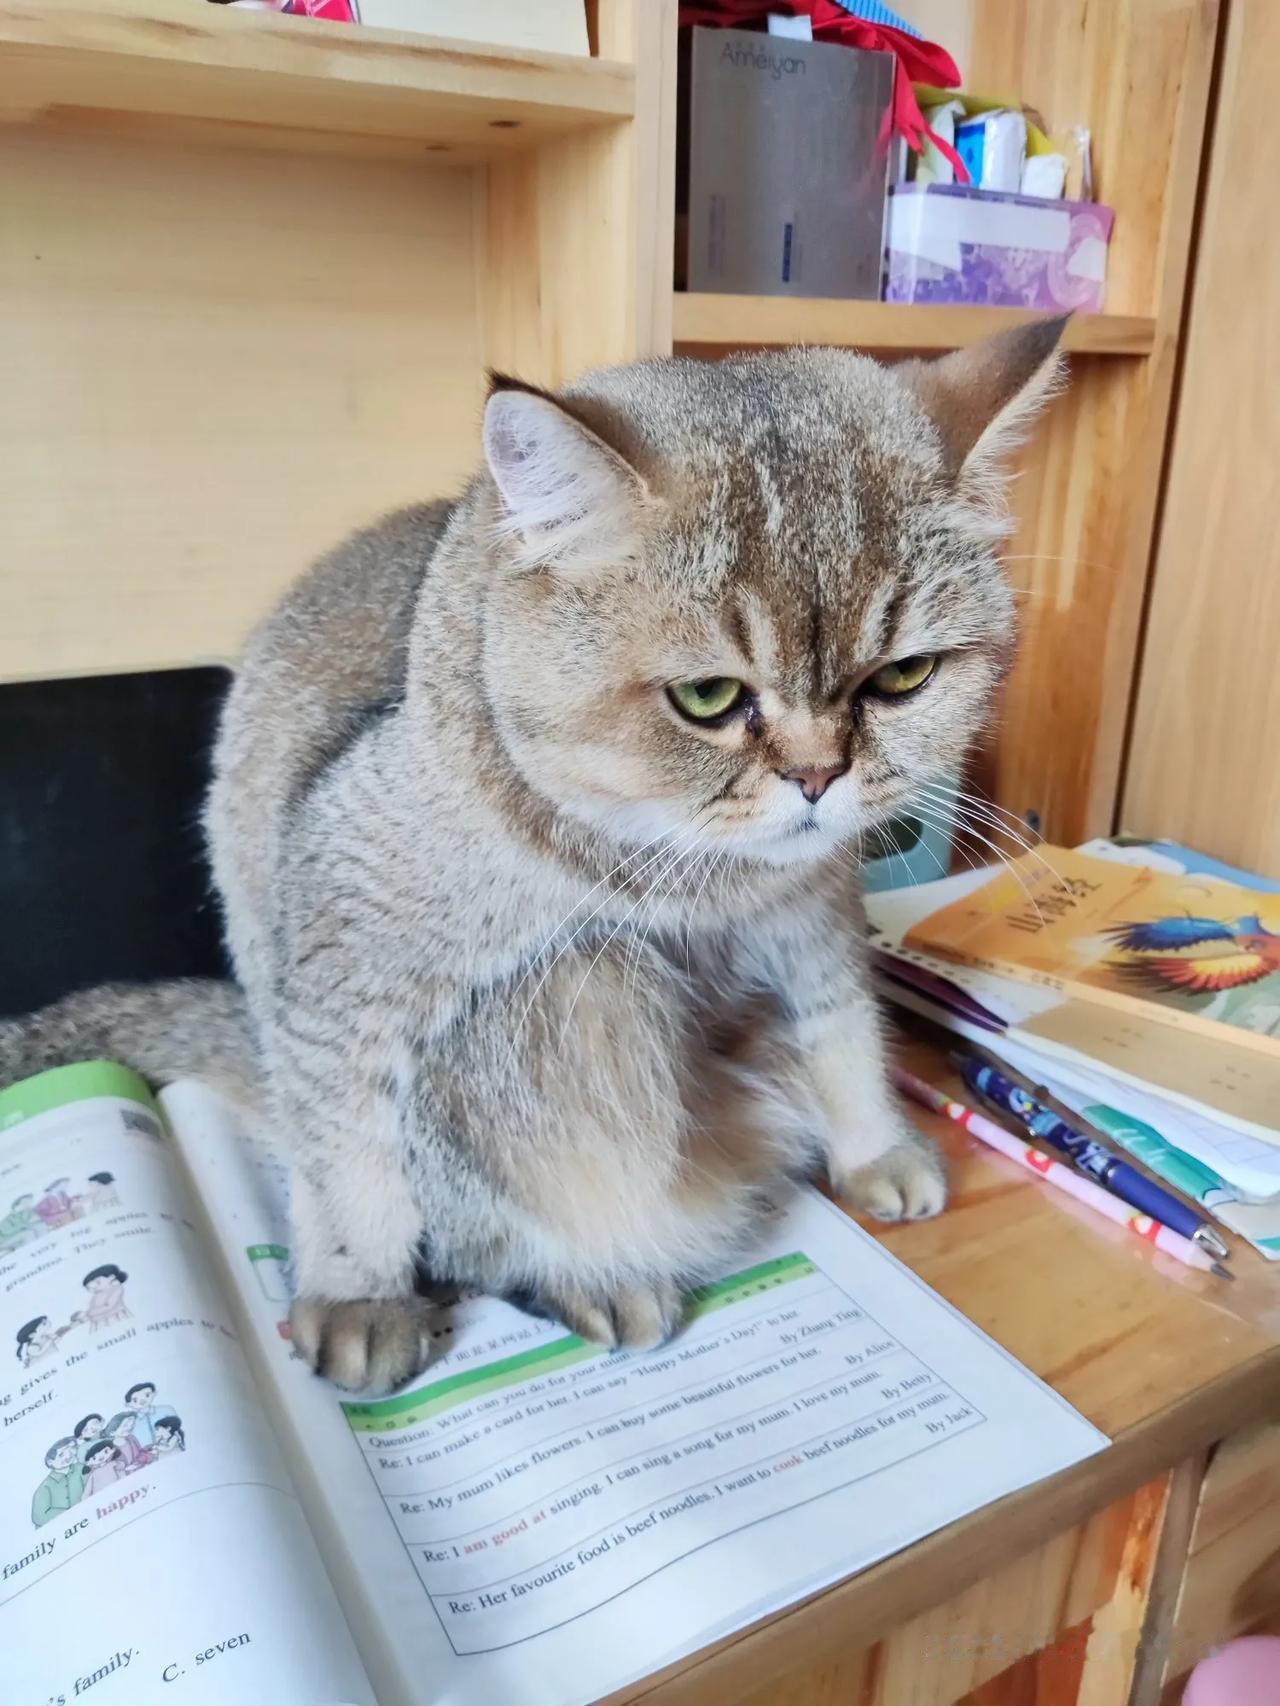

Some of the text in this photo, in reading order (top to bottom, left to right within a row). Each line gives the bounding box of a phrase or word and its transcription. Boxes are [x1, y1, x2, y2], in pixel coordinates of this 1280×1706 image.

[20, 1368, 58, 1396] gives
[65, 1351, 88, 1368] the
[97, 1328, 137, 1351] small
[146, 1317, 195, 1332] apples
[780, 1329, 799, 1345] By
[800, 1318, 837, 1338] Zhang
[844, 1340, 895, 1366] By Alice
[416, 1449, 442, 1463] can
[443, 1431, 482, 1454] make
[494, 1410, 523, 1429] card
[526, 1403, 545, 1416] for
[582, 1383, 606, 1397] can
[607, 1374, 628, 1389] say
[436, 1408, 473, 1429] What
[476, 1398, 500, 1412] can
[503, 1388, 527, 1404] you
[529, 1380, 546, 1393] do
[547, 1374, 566, 1387] for
[569, 1365, 596, 1382] your
[880, 1372, 934, 1401] By Betty
[428, 1496, 454, 1510] My
[457, 1479, 494, 1502] mum
[495, 1461, 530, 1483] likes
[596, 1423, 620, 1437] can
[620, 1413, 646, 1429] buy
[648, 1400, 682, 1419] some
[681, 1380, 736, 1405] beautiful
[736, 1363, 780, 1387] flowers
[780, 1355, 799, 1369] for
[925, 1405, 973, 1434] By Jack
[423, 1549, 450, 1563] Re:
[463, 1538, 489, 1555] am
[490, 1519, 530, 1546] good
[532, 1510, 547, 1525] at
[615, 1465, 641, 1481] can
[642, 1452, 673, 1471] sing
[683, 1438, 717, 1457] song
[714, 1430, 735, 1443] for
[736, 1422, 758, 1437] my
[801, 1392, 828, 1409] love
[829, 1383, 850, 1399] my
[2, 1483, 157, 1580] family are happy.
[448, 1600, 477, 1616] Re:
[478, 1589, 508, 1609] Her
[510, 1560, 578, 1598] favourite
[577, 1539, 612, 1566] food
[612, 1531, 627, 1546] is
[625, 1512, 659, 1537] beef
[724, 1473, 759, 1493] want
[757, 1467, 772, 1480] to
[772, 1454, 804, 1473] cook
[803, 1440, 833, 1460] beef
[832, 1423, 879, 1450] noodles
[876, 1415, 897, 1429] for
[896, 1404, 918, 1421] my
[72, 1646, 140, 1697] family.
[162, 1632, 251, 1683] C. seven
